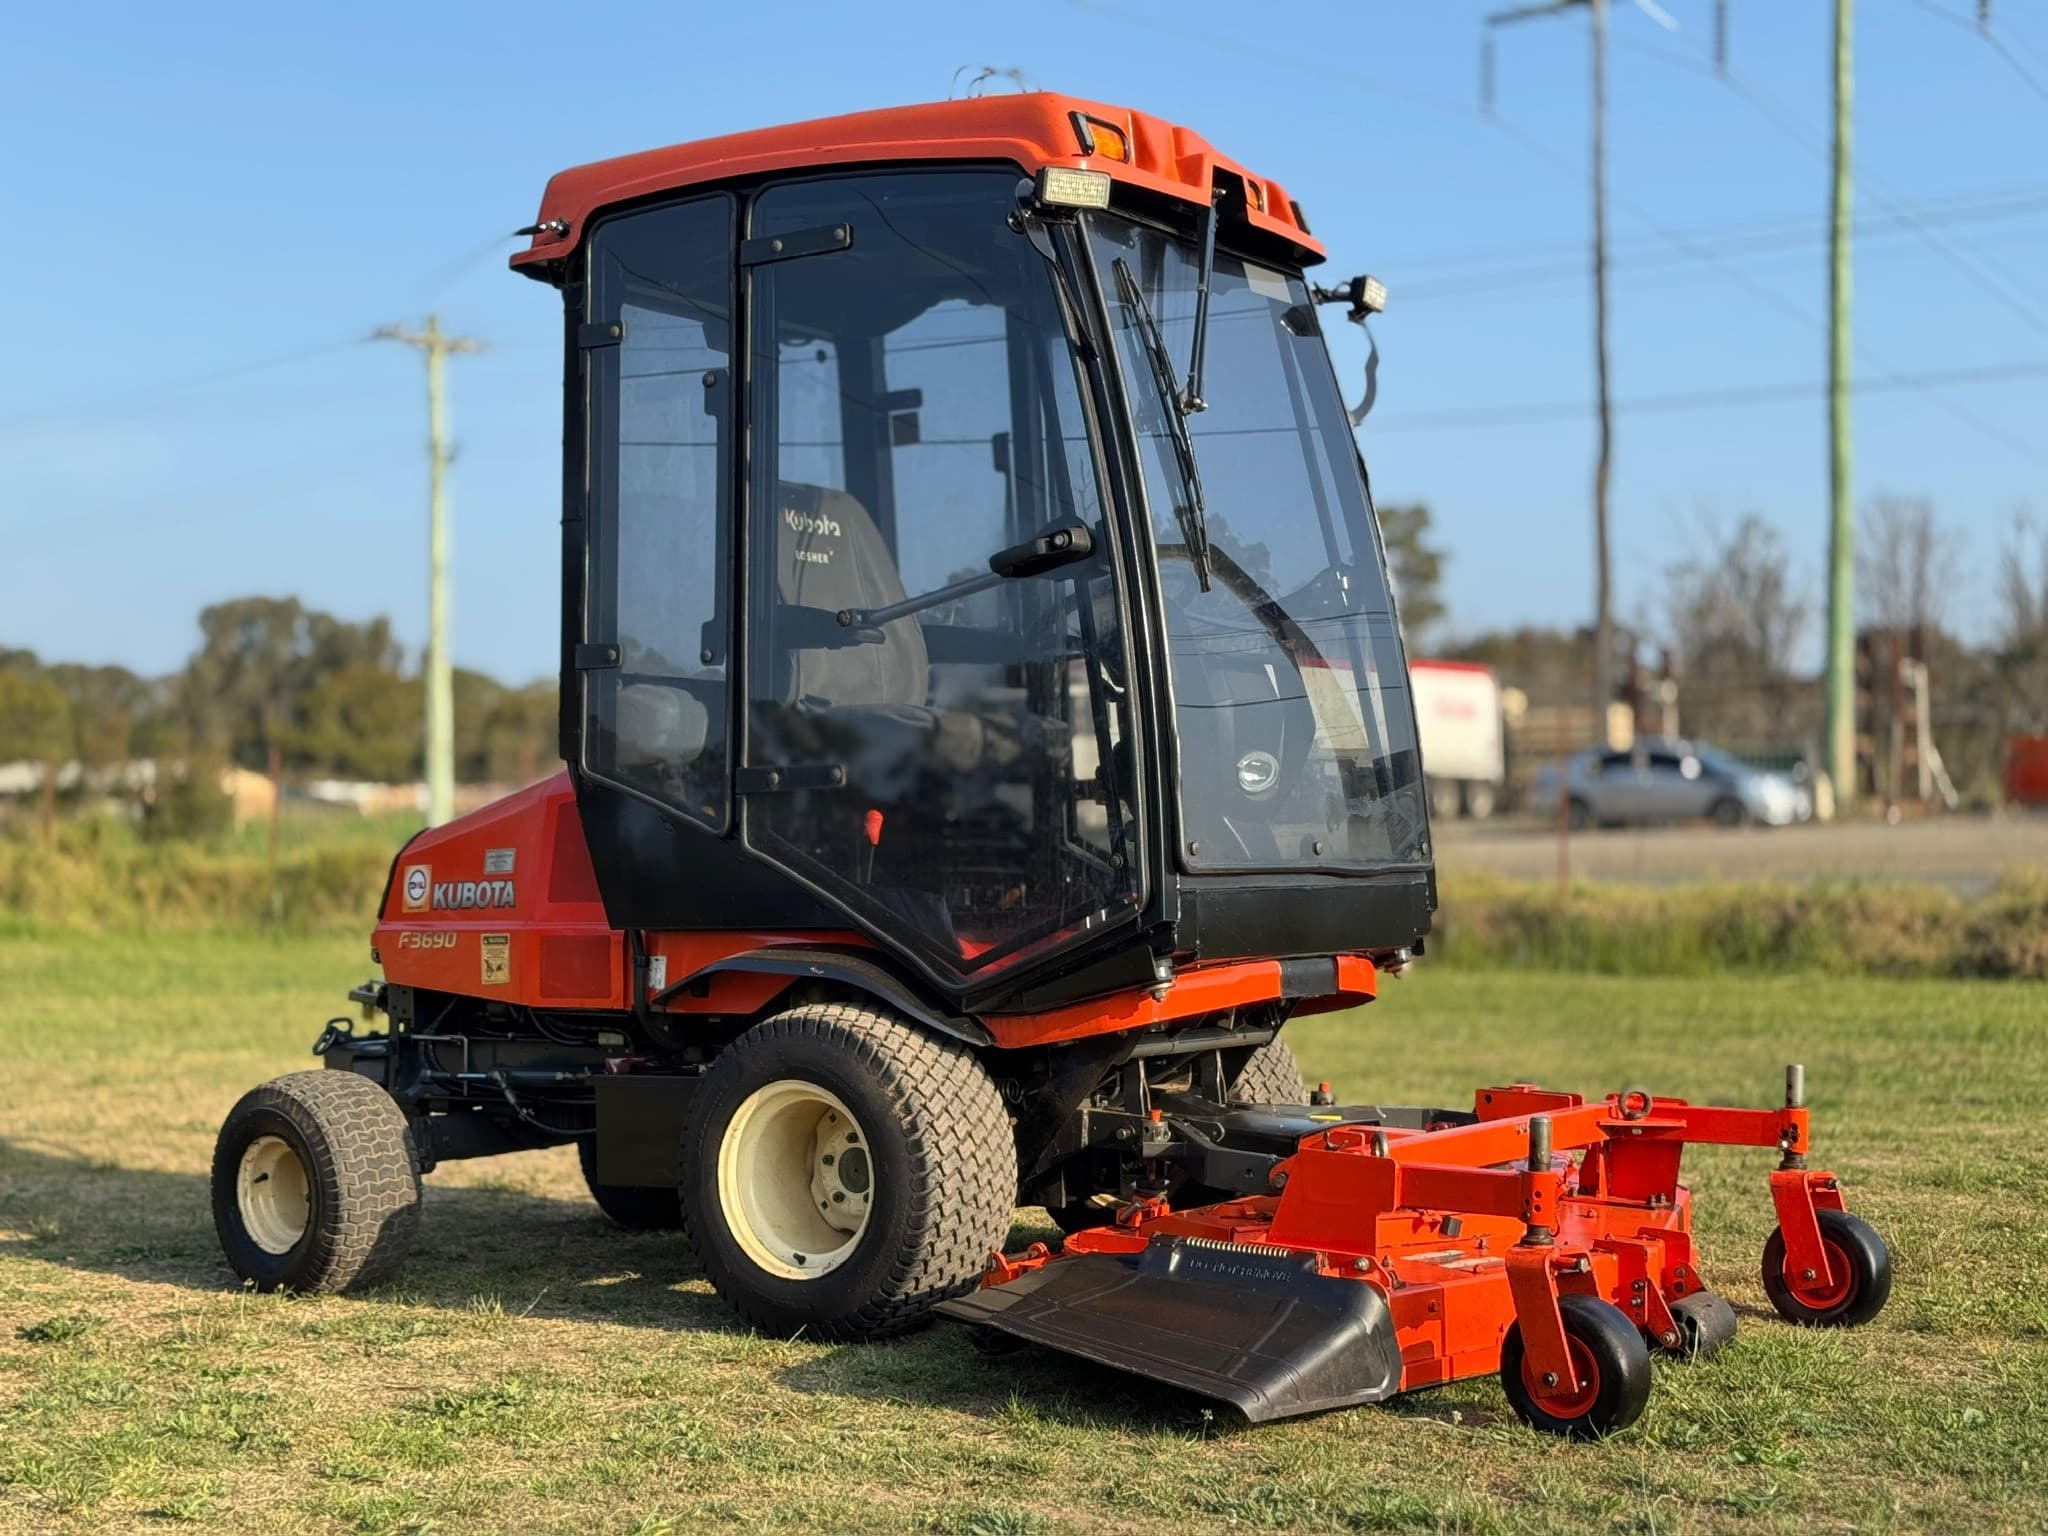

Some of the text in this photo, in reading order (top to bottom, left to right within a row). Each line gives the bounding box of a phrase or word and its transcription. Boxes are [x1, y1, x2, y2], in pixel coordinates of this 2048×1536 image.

[785, 508, 841, 537] Kubota
[432, 880, 516, 910] KUBOTA
[398, 931, 457, 948] F3690
